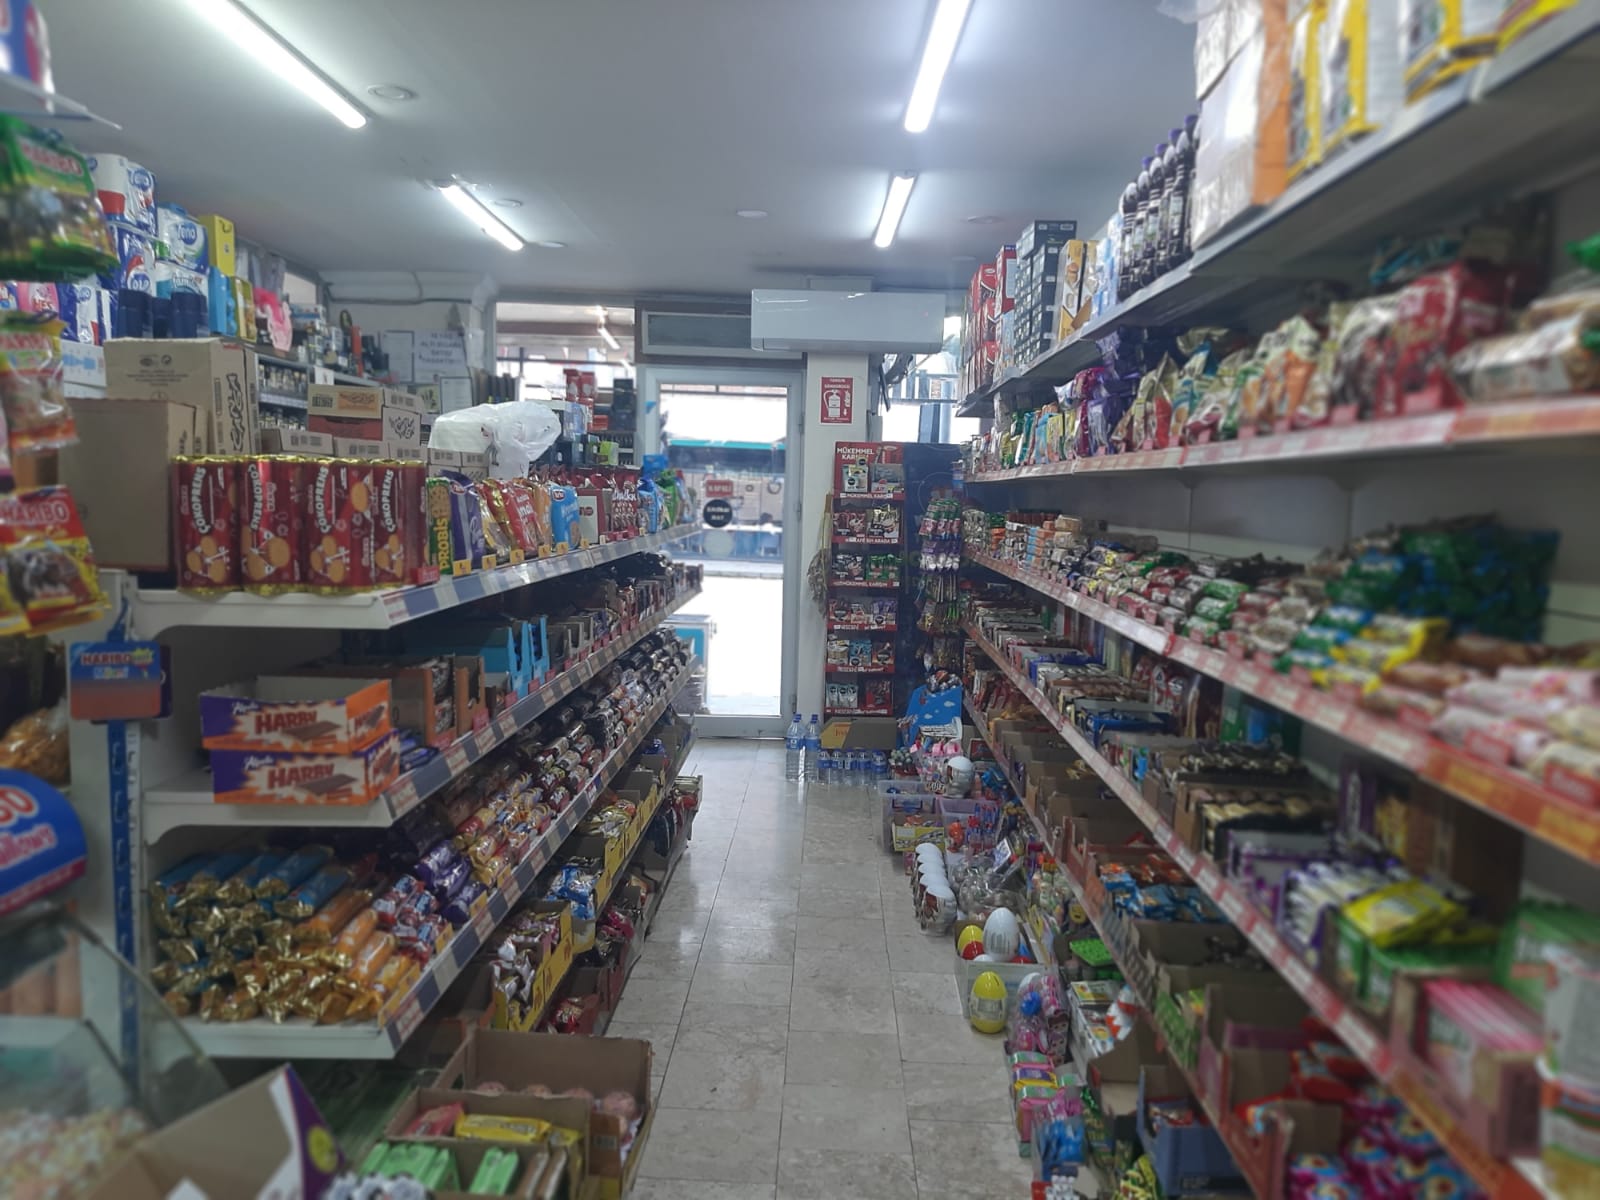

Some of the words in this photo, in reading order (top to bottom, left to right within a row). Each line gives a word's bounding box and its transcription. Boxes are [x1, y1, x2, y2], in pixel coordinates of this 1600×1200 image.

[837, 446, 875, 455] MÜKEMMEL
[191, 466, 211, 534] ÇOKOPRENS
[248, 463, 263, 531] ÇOKOPRENS
[315, 465, 331, 534] ÇOKOPRENS
[382, 468, 396, 533] ÇOKOPRENS
